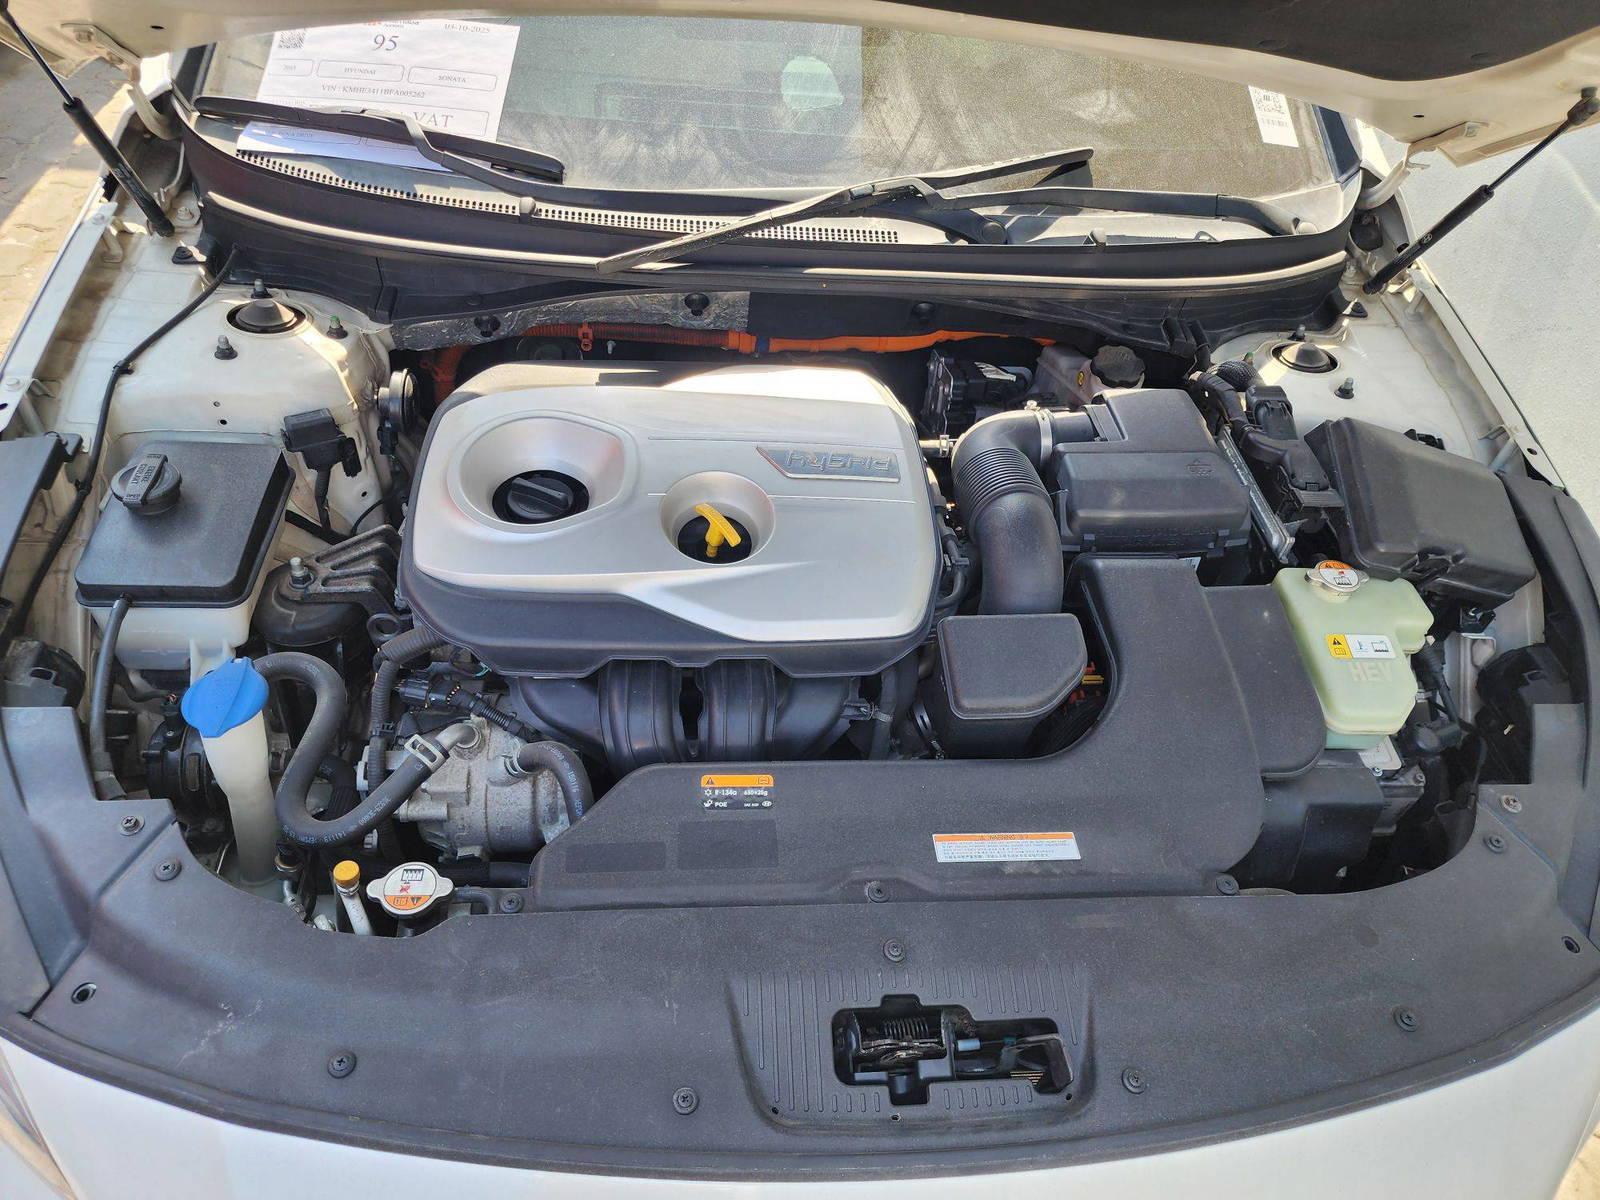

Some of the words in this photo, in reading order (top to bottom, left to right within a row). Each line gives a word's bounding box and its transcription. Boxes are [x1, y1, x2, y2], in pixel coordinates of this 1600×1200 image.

[371, 33, 399, 51] 95
[344, 67, 376, 75] HYUNDAI
[438, 75, 466, 83] SONATA
[321, 84, 337, 92] VIN
[413, 111, 454, 128] VAT
[1351, 661, 1392, 682] HEV
